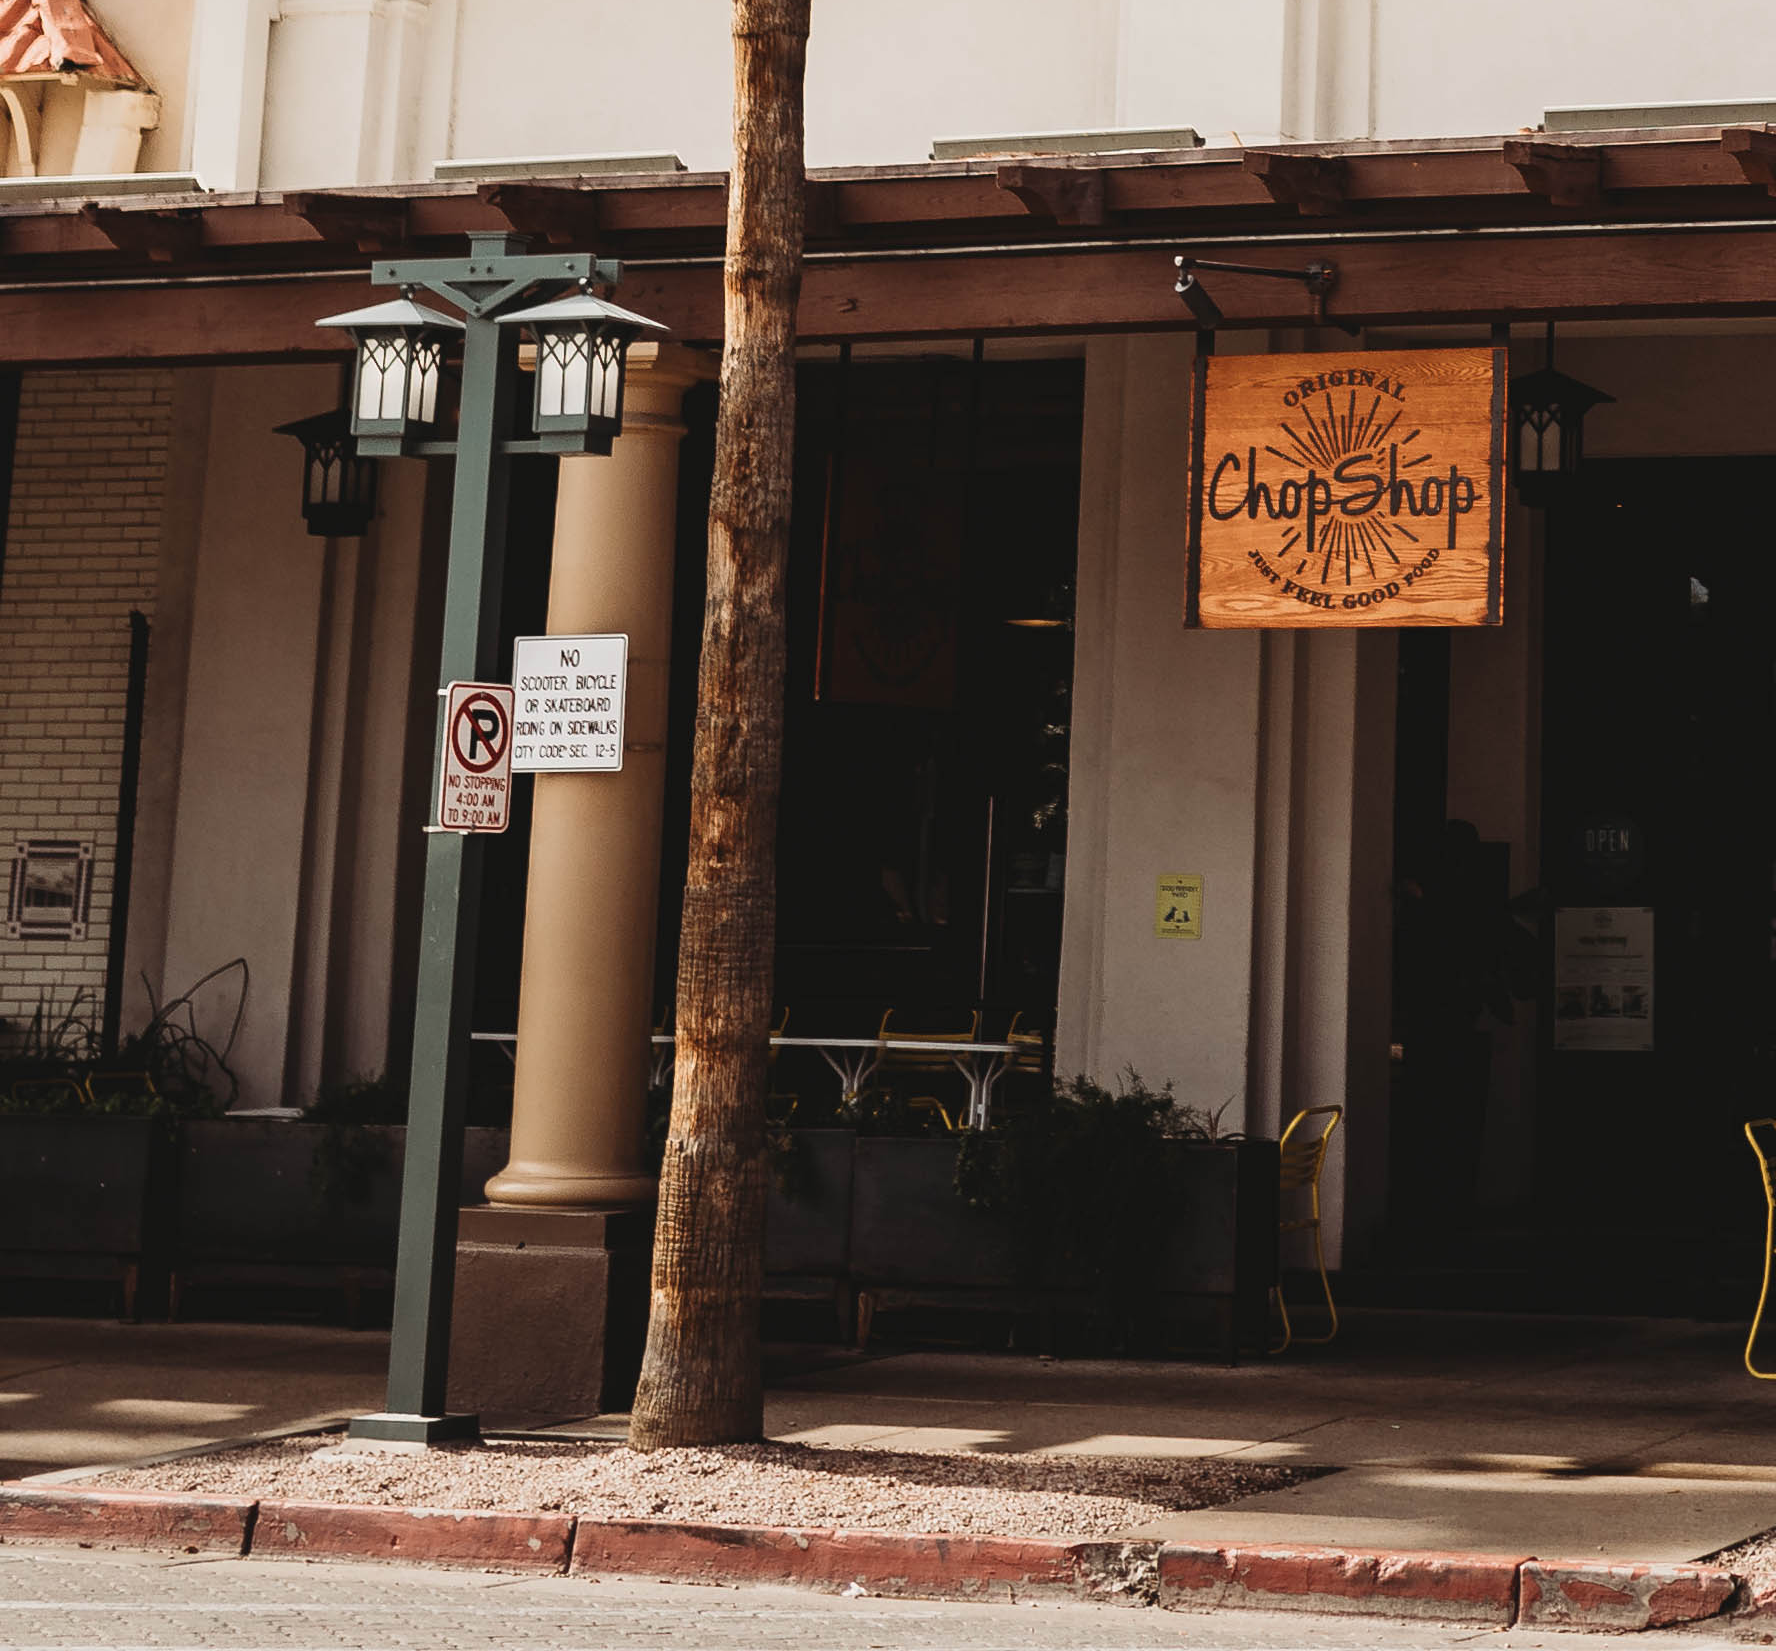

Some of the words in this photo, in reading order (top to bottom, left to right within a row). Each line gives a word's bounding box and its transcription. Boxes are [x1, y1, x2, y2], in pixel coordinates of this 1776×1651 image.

[1283, 369, 1406, 407] ORIGINAL
[1208, 442, 1483, 553] ChopShop
[1248, 549, 1280, 584] JUST
[1280, 578, 1336, 610] FEEL
[1342, 581, 1400, 609] GOOD
[1402, 547, 1440, 587] FOOD
[560, 649, 580, 667] NO
[576, 674, 617, 690] BICYCLE
[525, 699, 539, 713] OR
[544, 697, 611, 713] SKATEBOARD
[516, 721, 545, 735] RIDING
[550, 721, 563, 735] ON
[567, 720, 617, 735] SIDEWALKS
[514, 745, 534, 759] CITY
[595, 744, 616, 758] 12-5
[448, 775, 461, 788] NO
[464, 776, 506, 791] STOPPING
[456, 792, 478, 806] 4:00
[482, 794, 495, 807] AM
[448, 808, 459, 822] TO
[462, 809, 484, 824] 9:00
[487, 811, 501, 825] AM
[1585, 829, 1630, 851] OPEN
